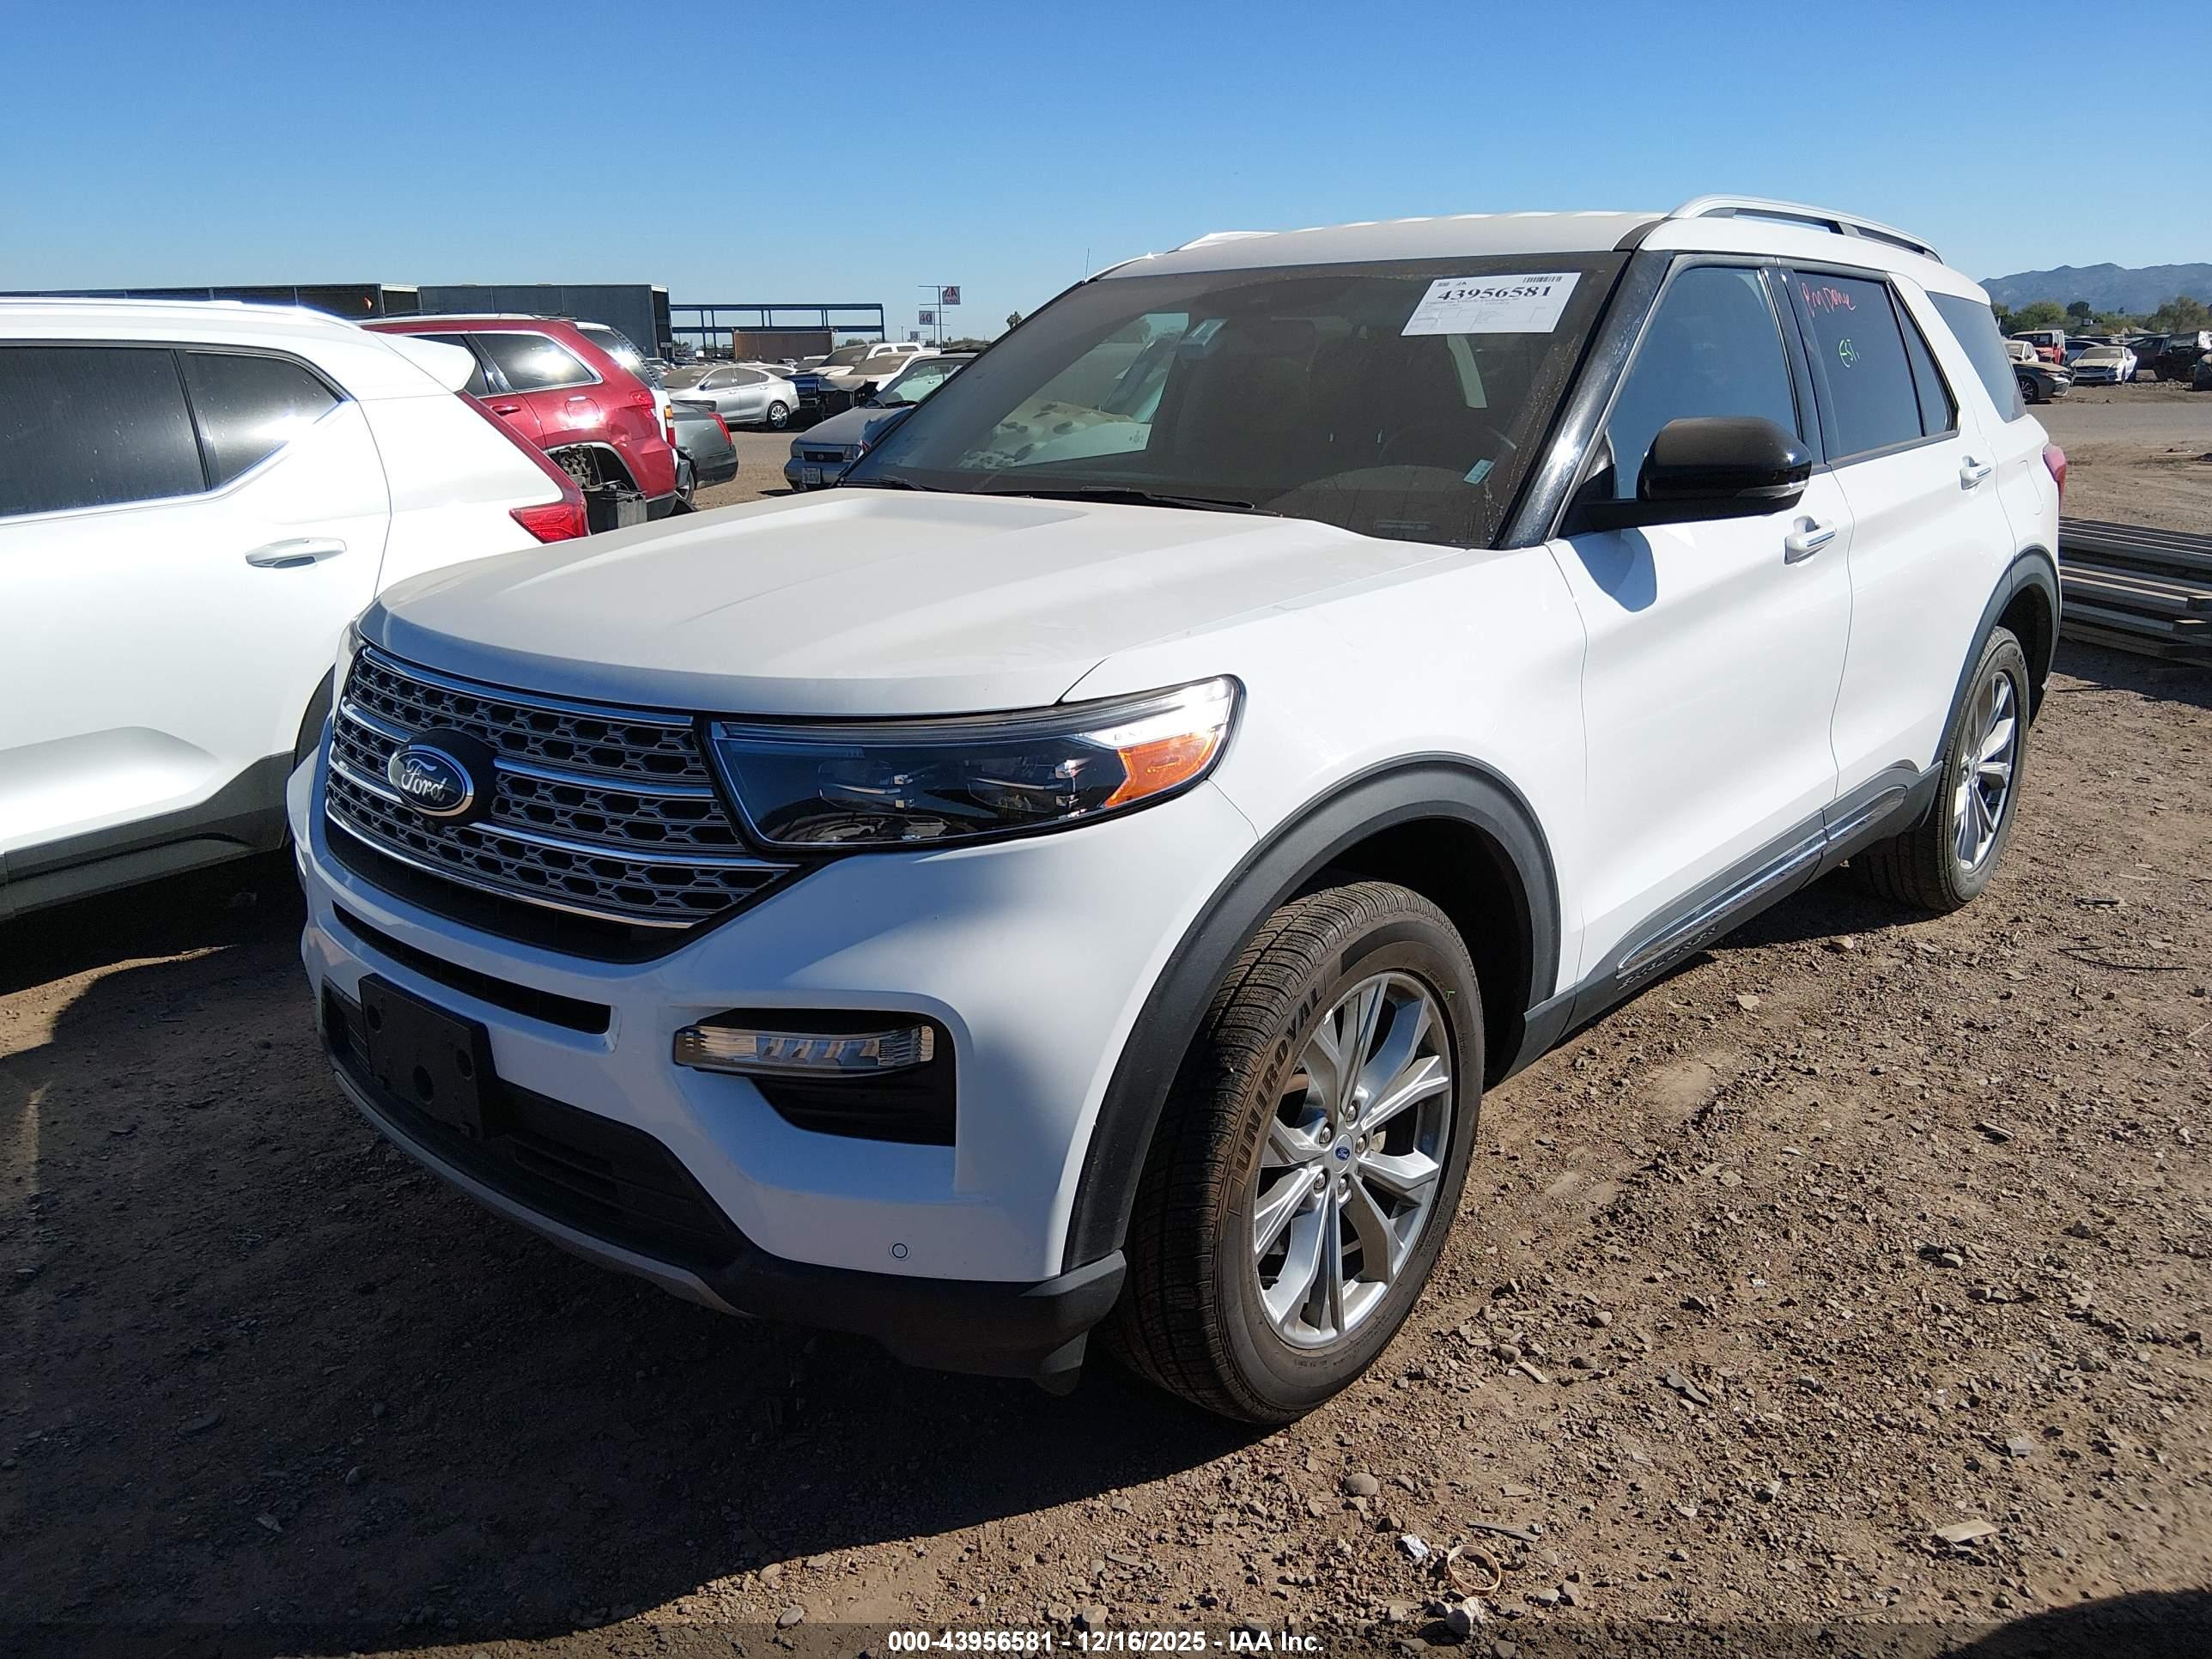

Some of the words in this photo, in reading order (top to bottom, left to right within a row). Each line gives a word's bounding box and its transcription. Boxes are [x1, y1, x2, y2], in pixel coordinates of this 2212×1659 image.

[1437, 285, 1552, 301] 43956581
[401, 758, 447, 802] Ford
[1236, 988, 1322, 1171] UNIROYAL
